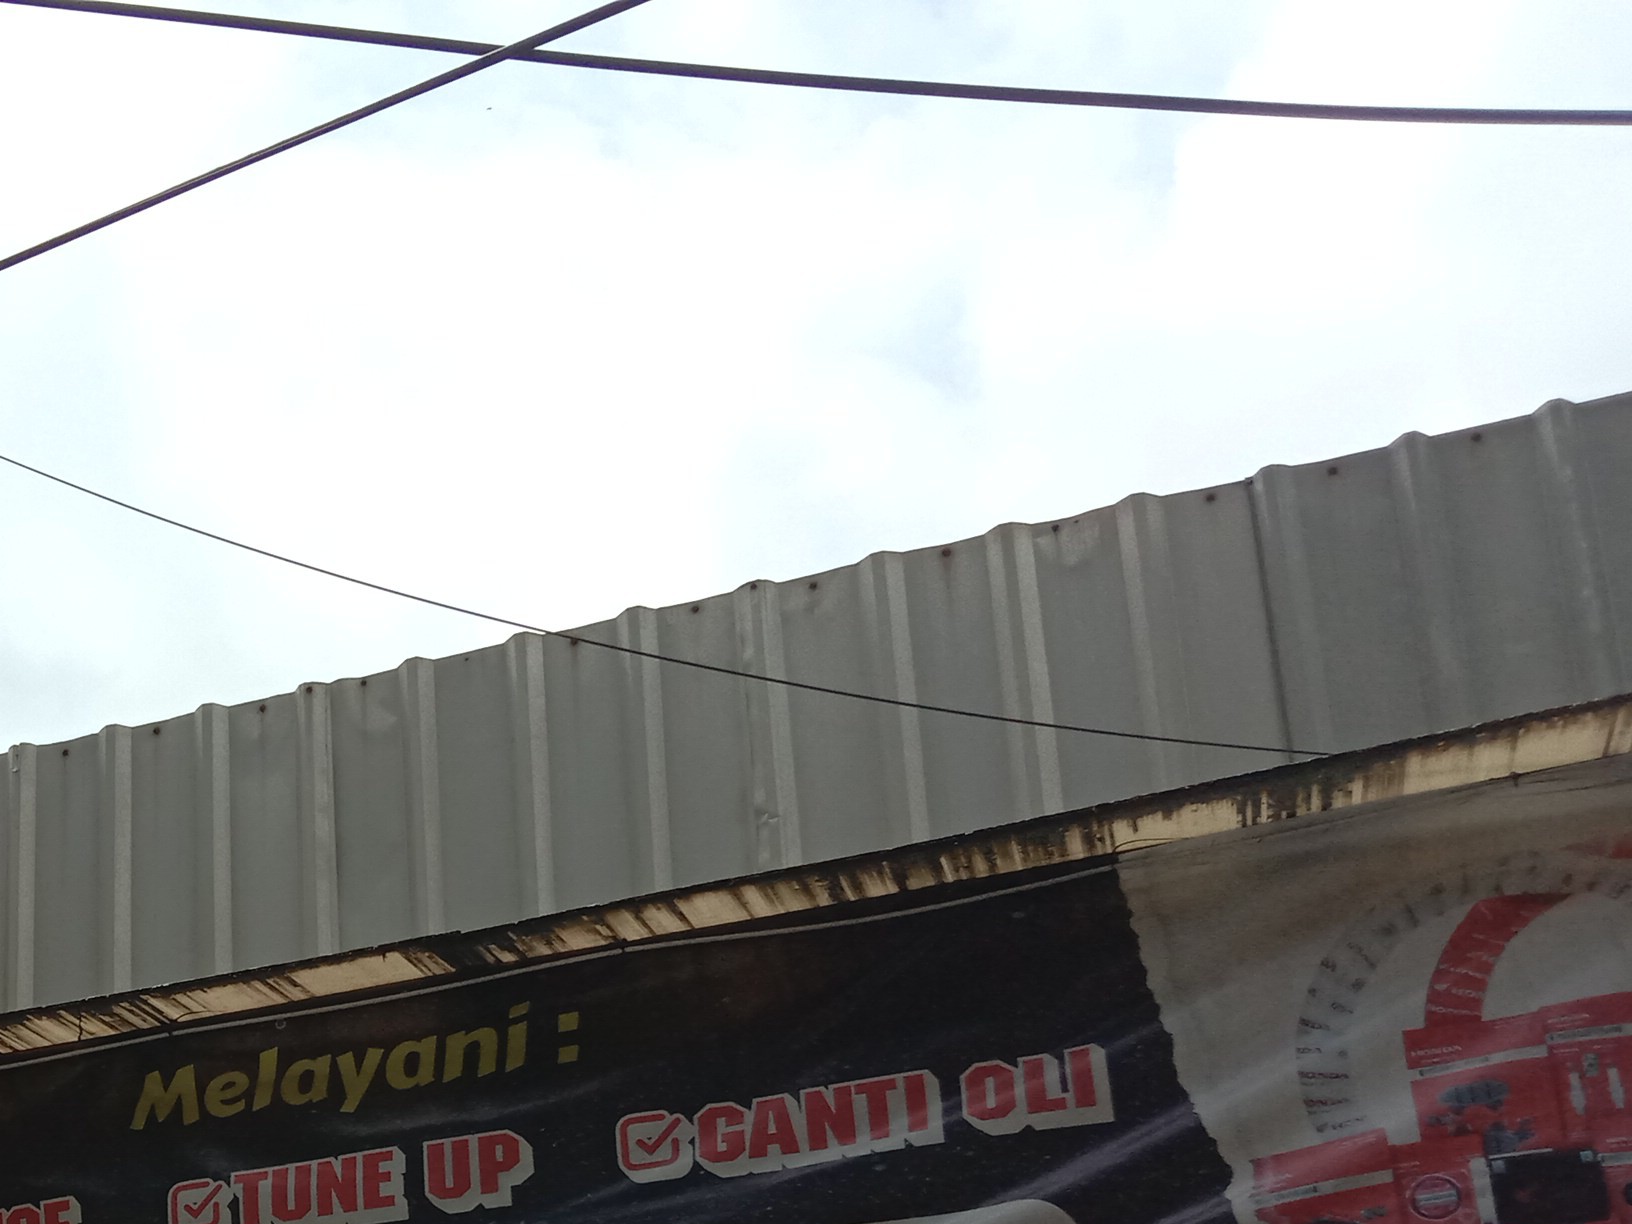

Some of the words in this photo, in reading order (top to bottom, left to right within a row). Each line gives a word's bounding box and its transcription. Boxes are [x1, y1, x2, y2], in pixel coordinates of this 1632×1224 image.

[129, 1002, 530, 1130] Melayani
[422, 1129, 534, 1214] UP
[693, 1069, 944, 1178] GANTI
[960, 1043, 1115, 1136] OLI
